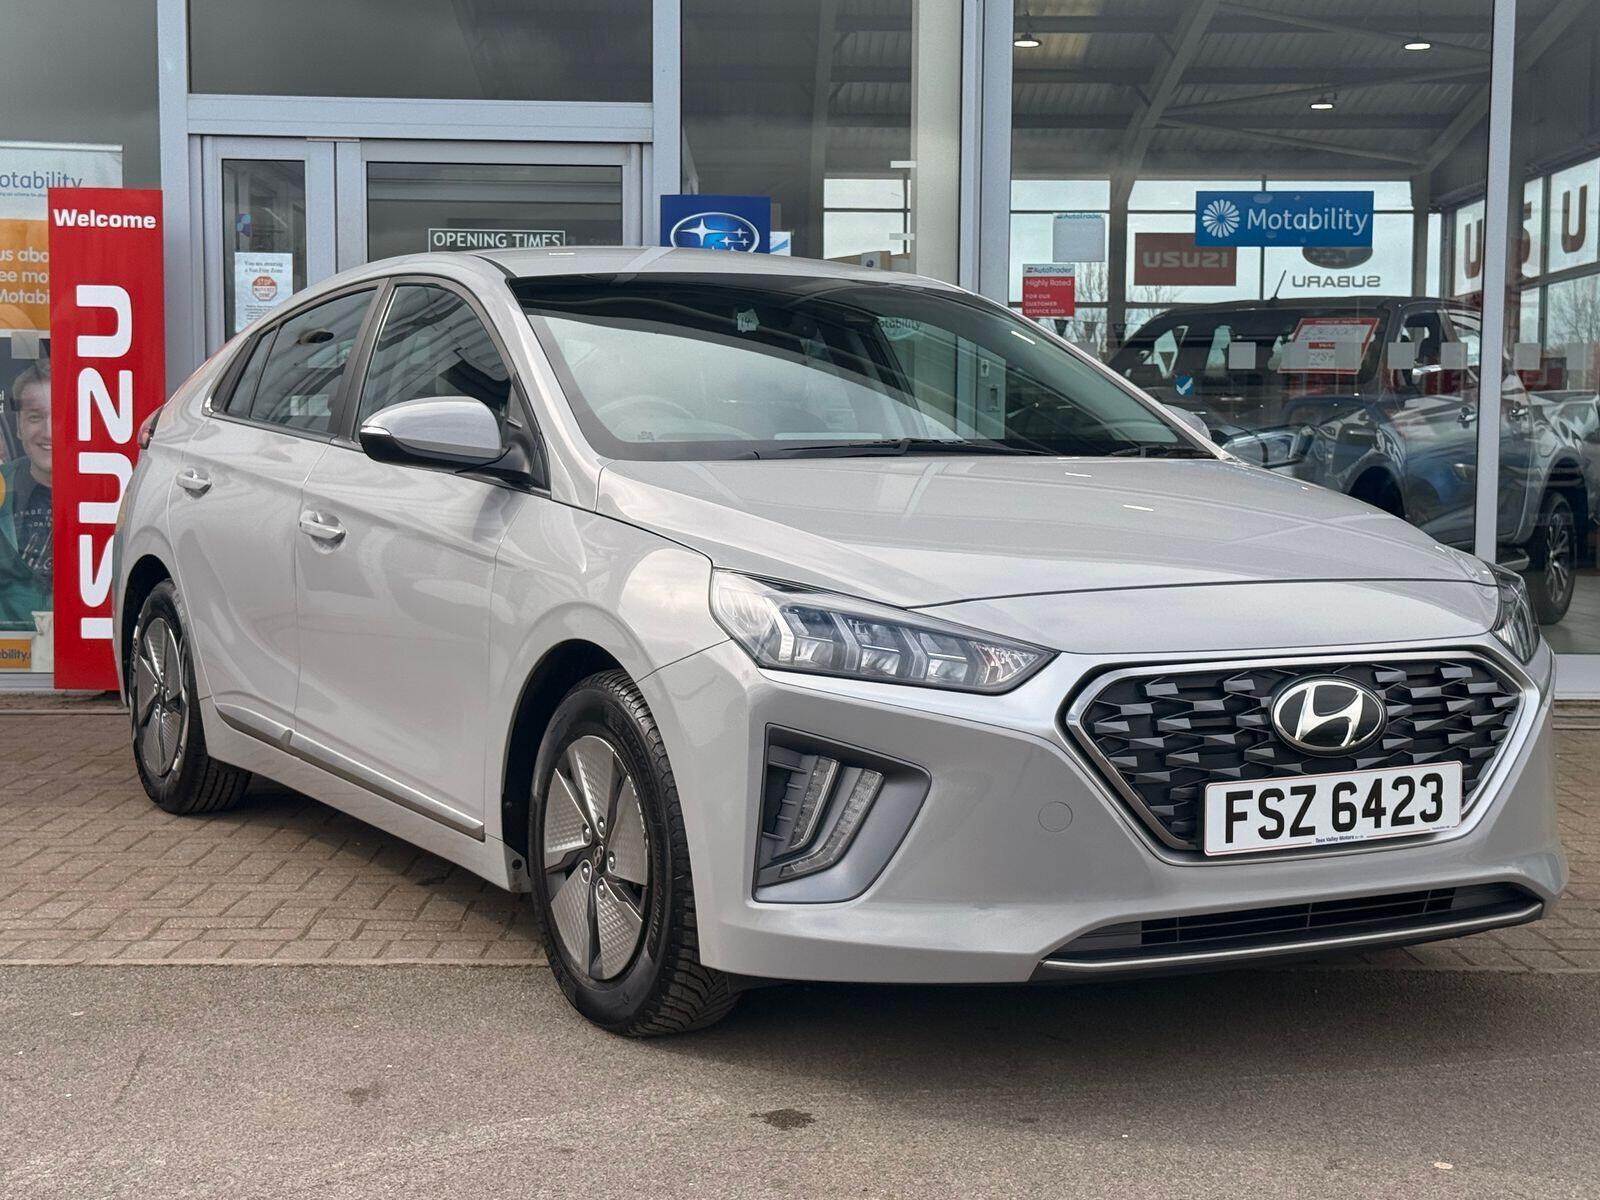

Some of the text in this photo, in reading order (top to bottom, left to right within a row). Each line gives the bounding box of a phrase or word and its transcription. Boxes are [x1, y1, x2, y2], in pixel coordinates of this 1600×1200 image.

[53, 208, 156, 229] Welcome
[1247, 197, 1368, 236] Motability
[433, 231, 561, 247] OPENING TIMES
[1033, 266, 1073, 274] AutoTrader
[1025, 279, 1072, 288] Highly Rated
[1225, 772, 1444, 844] FSZ 6423
